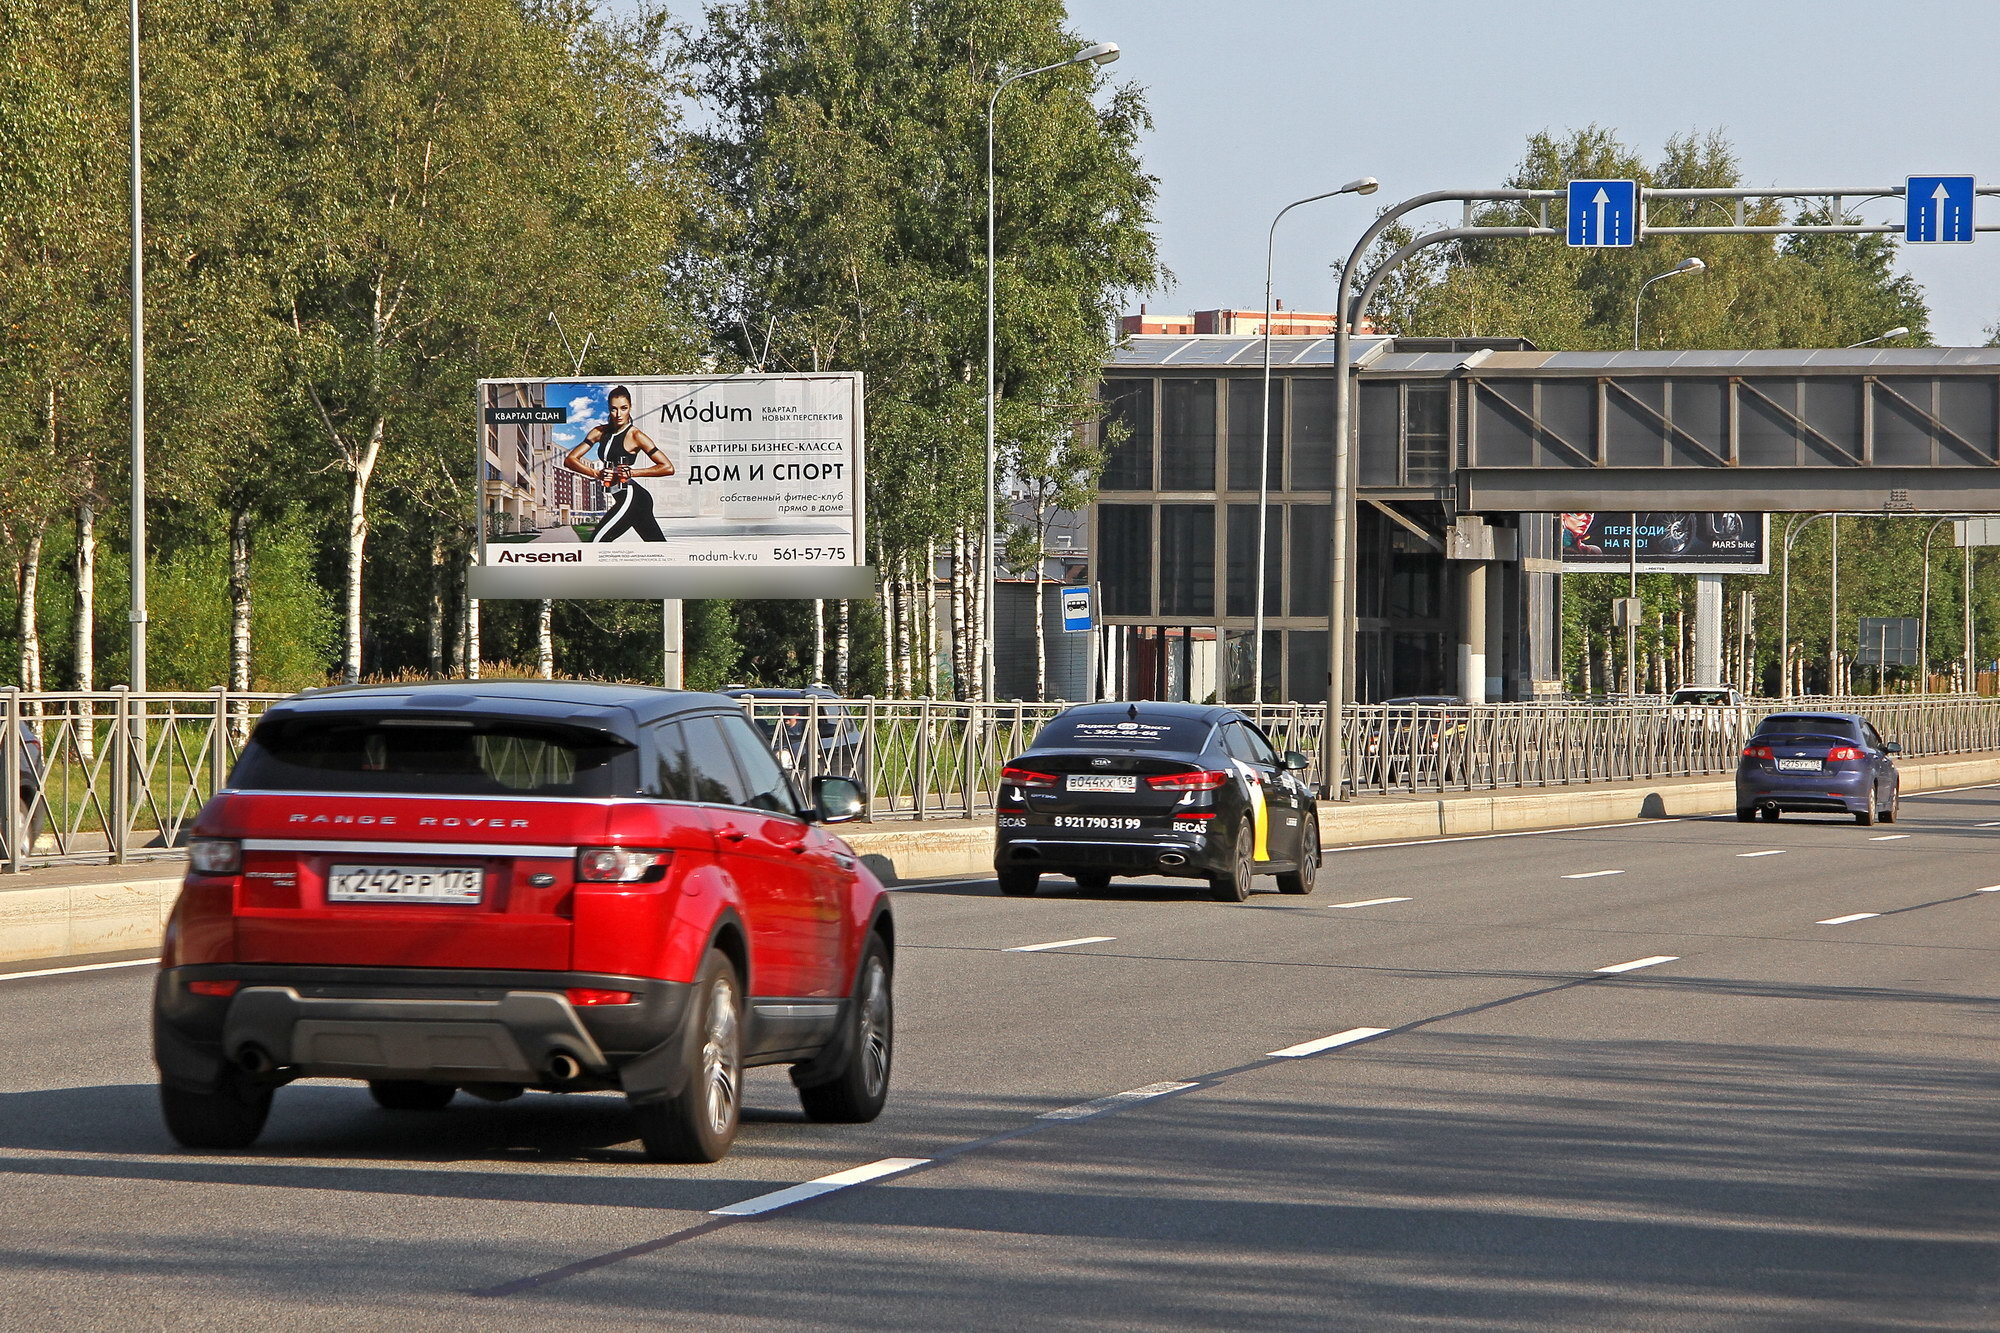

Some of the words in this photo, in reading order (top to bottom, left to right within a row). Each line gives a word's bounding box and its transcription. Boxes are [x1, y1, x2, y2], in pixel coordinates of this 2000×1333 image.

[495, 412, 533, 420] КВАРТАЛ
[535, 412, 560, 421] СДАН
[660, 399, 752, 423] Módum
[689, 443, 747, 453] КВАРТИРЫ
[751, 442, 843, 452] БИЗНЕС-КЛАССА
[688, 464, 741, 485] ДОМ
[749, 464, 764, 481] И
[772, 464, 844, 480] СПОРТ
[719, 493, 781, 502] собственный
[784, 491, 844, 504] фитнес-клуб
[778, 505, 808, 514] прямо
[819, 504, 844, 512] доме
[1604, 539, 1620, 548] НА
[1623, 539, 1648, 548] RD!
[1712, 541, 1736, 549] MARS
[498, 550, 582, 563] Arsenal
[689, 550, 758, 562] modum-kv.ru
[773, 547, 846, 560] 561-57-75
[1070, 776, 1113, 788] В044КХ
[1116, 776, 1133, 786] 198
[289, 813, 398, 825] RANGE
[418, 816, 530, 828] ROVER
[1054, 816, 1063, 827] 8
[1065, 817, 1085, 828] 921
[1086, 817, 1109, 829] 790
[1109, 818, 1123, 829] 31
[1125, 819, 1141, 829] 99
[1173, 822, 1207, 833] BECAS
[337, 869, 433, 893] К242РР
[440, 869, 474, 888] 178
